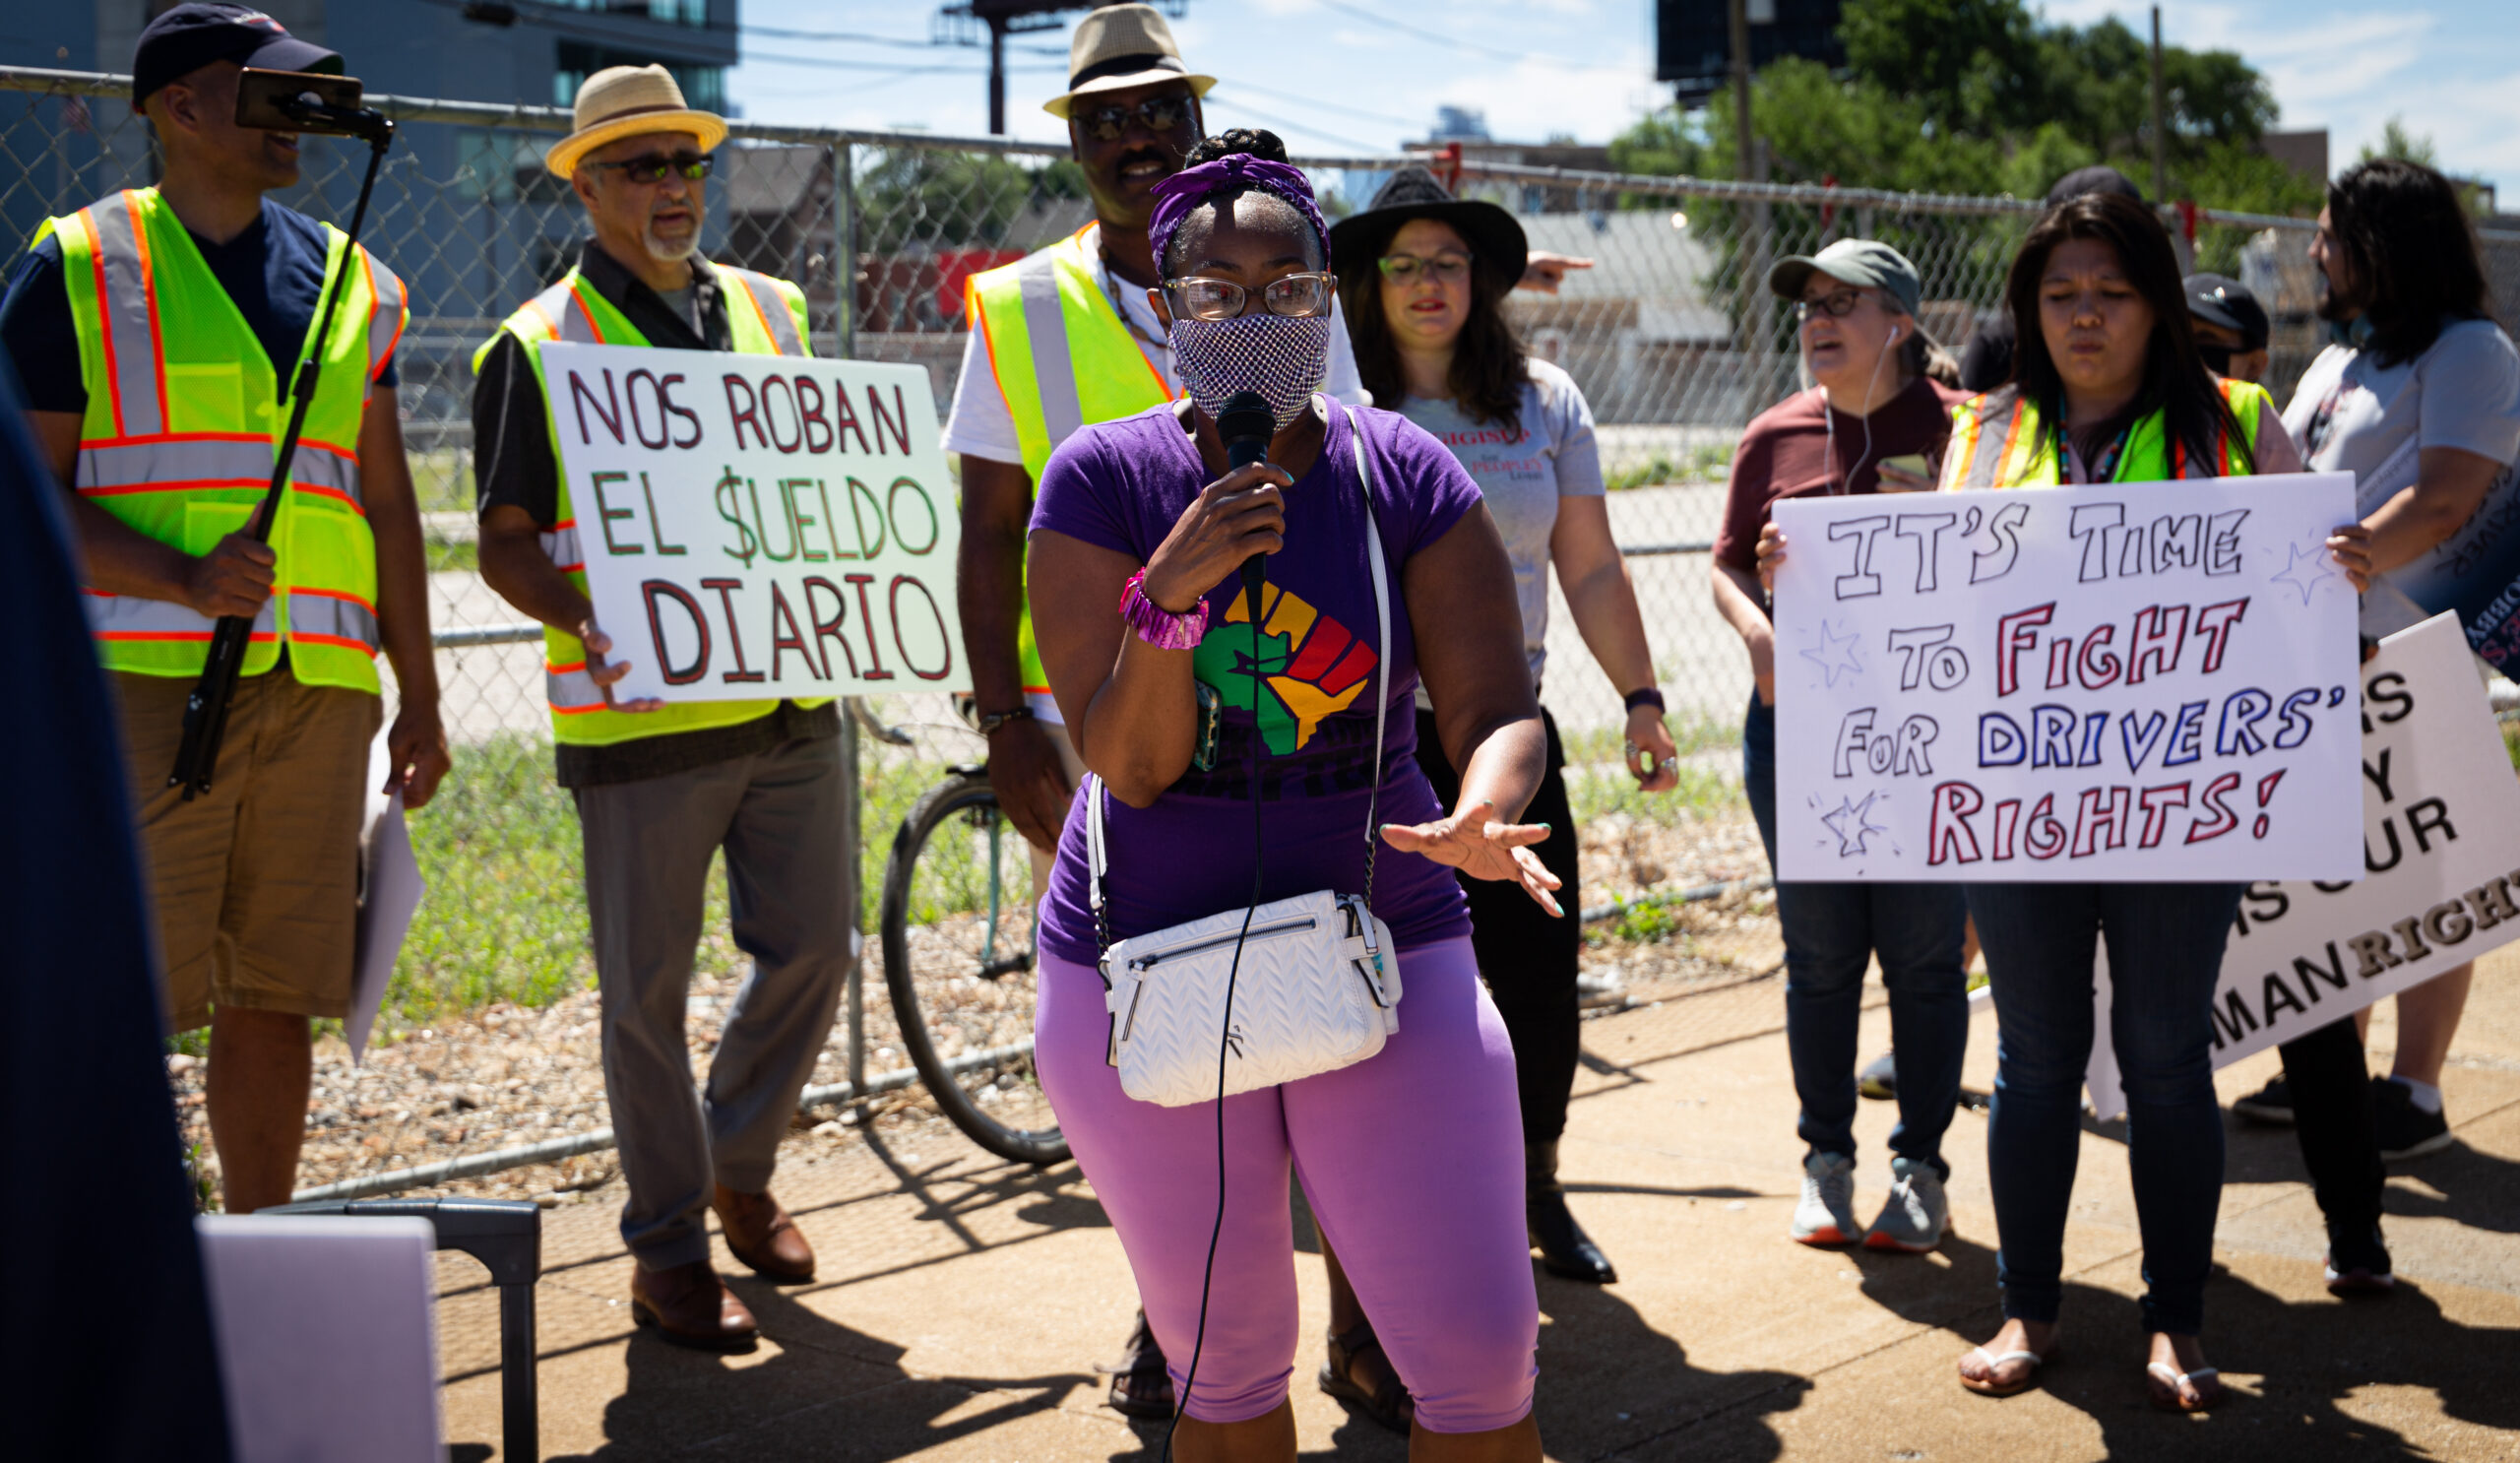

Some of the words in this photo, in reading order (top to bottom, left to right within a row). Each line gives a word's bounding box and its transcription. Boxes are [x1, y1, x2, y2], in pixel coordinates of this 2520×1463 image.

[568, 368, 703, 451] NOS
[722, 373, 912, 456] ROBAN
[591, 471, 688, 556] EL
[715, 465, 939, 569] $UELDO
[1827, 502, 2030, 602] IT'S
[2069, 502, 2251, 584] TIME
[641, 574, 952, 686] DIARIO
[1888, 623, 1970, 692] TO
[1996, 596, 2251, 697] FIGHT
[1833, 707, 1939, 778] FOR
[1978, 686, 2346, 775] DRIVERS'
[1926, 767, 2288, 866] RIGHTS!
